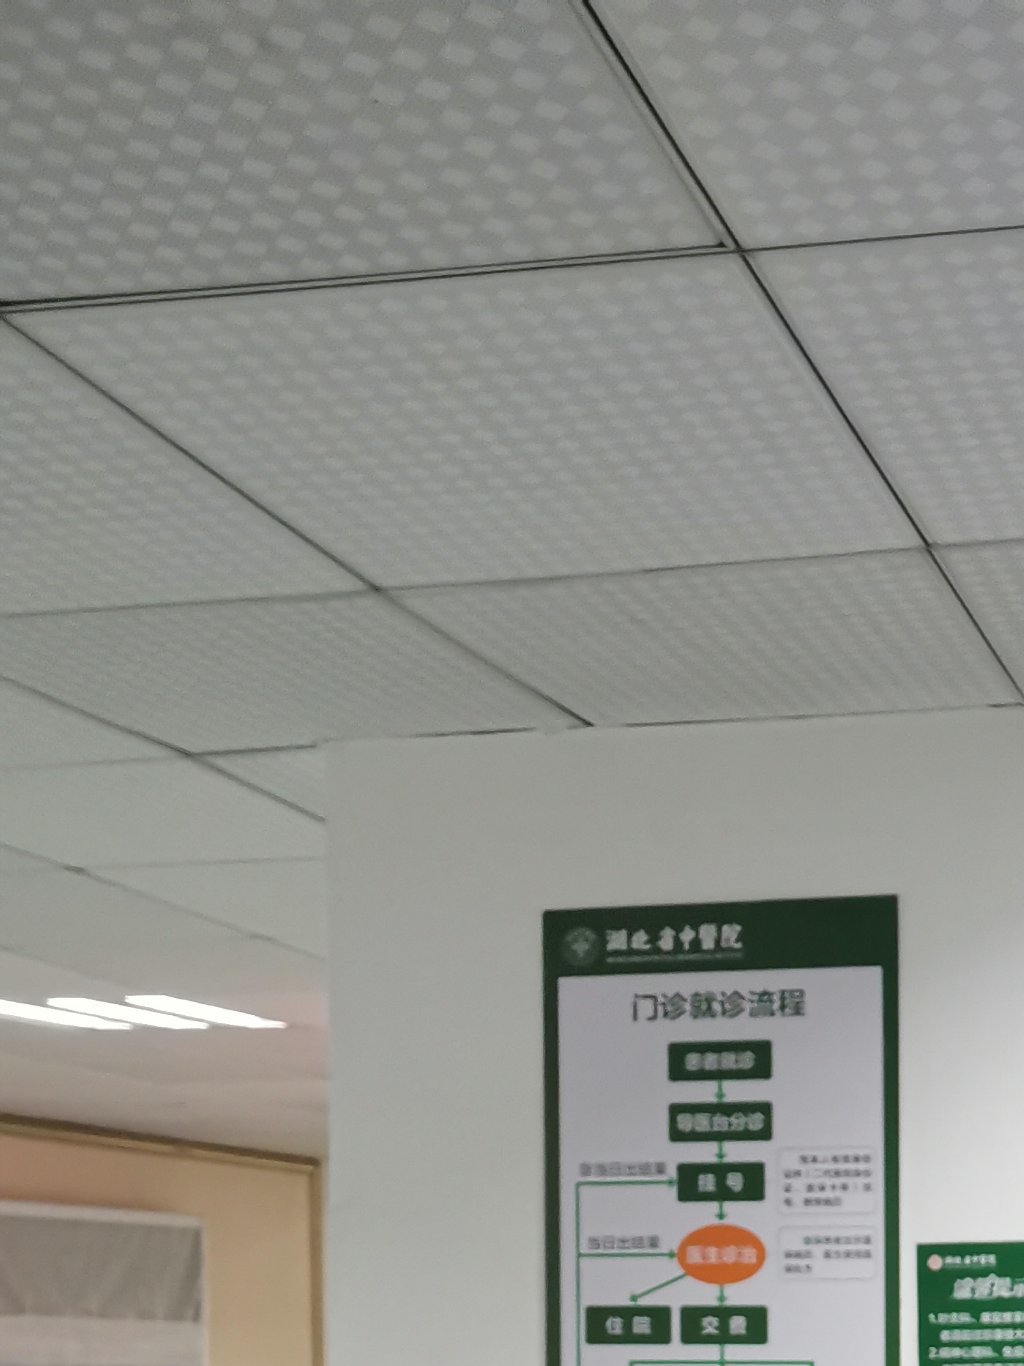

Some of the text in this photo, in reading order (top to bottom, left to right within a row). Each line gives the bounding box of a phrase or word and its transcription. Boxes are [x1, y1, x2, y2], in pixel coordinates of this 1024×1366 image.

[632, 988, 806, 1022] 门诊就诊流程
